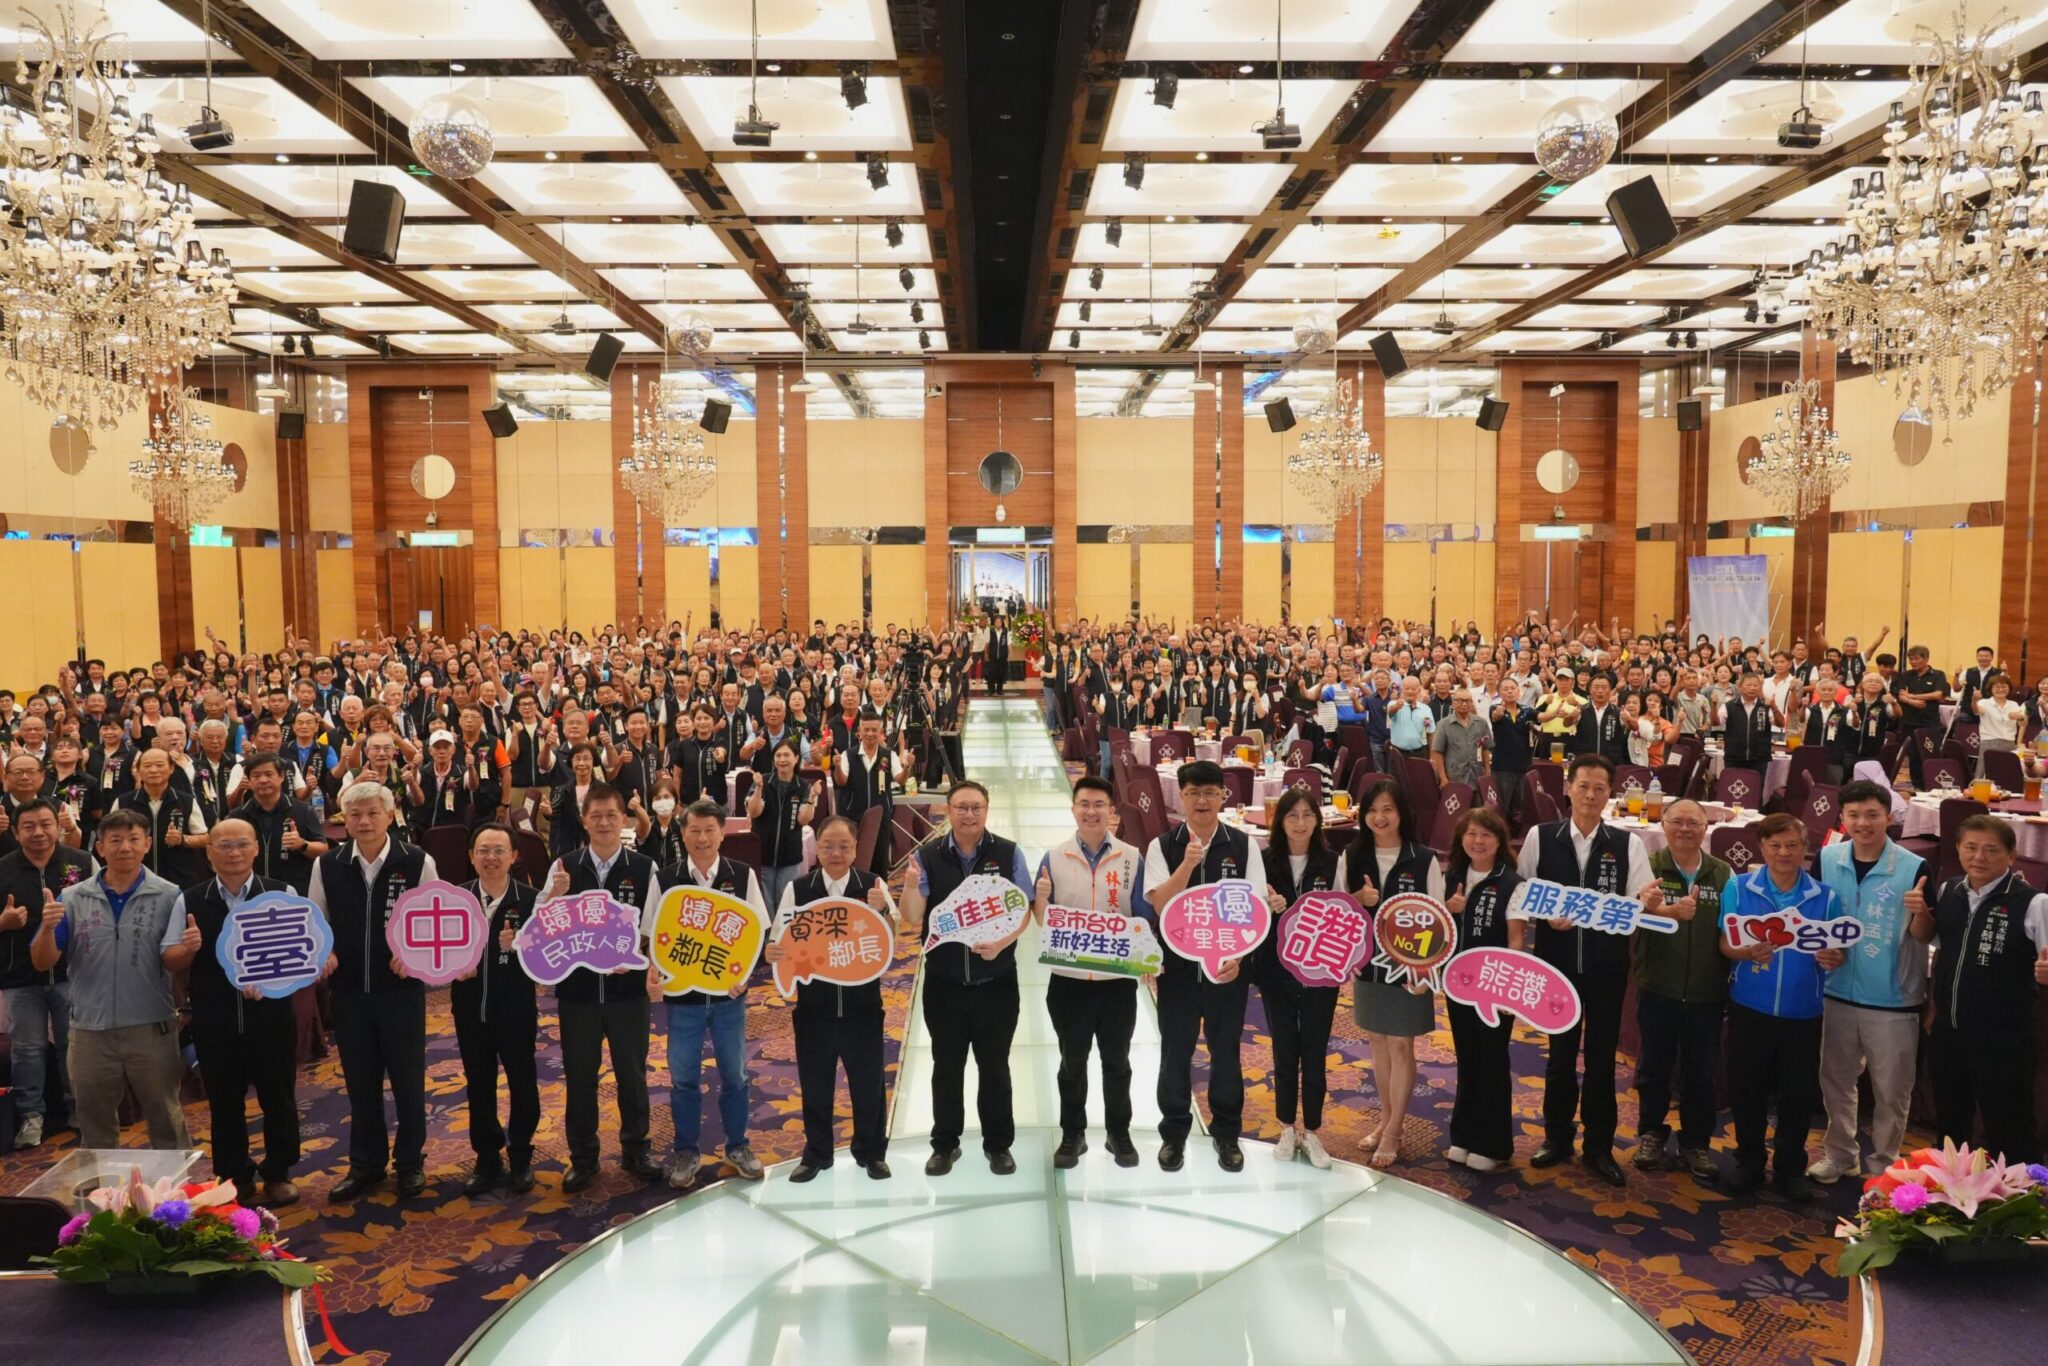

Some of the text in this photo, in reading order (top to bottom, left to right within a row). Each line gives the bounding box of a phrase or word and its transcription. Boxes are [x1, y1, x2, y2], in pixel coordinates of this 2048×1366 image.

[937, 889, 1026, 934] 最佳主角
[1105, 870, 1121, 913] 林昊
[1183, 884, 1252, 925] 特優
[1521, 883, 1673, 931] 服務第一
[405, 896, 470, 969] 中
[538, 895, 607, 935] 績優
[679, 895, 747, 947] 績優
[783, 907, 848, 942] 資深
[1047, 908, 1127, 935] 富市台中
[1395, 910, 1435, 929] 台中
[1797, 920, 1861, 950] 台中
[234, 906, 317, 983] 臺
[542, 931, 632, 968] 民政人員
[669, 933, 730, 980] 鄰長
[828, 935, 882, 968] 鄰長
[1050, 929, 1130, 957] 新好生活
[1193, 928, 1237, 951] 里長
[1285, 898, 1367, 982] 讚
[1394, 929, 1434, 958] No.1
[1477, 955, 1548, 1009] 熊讚
